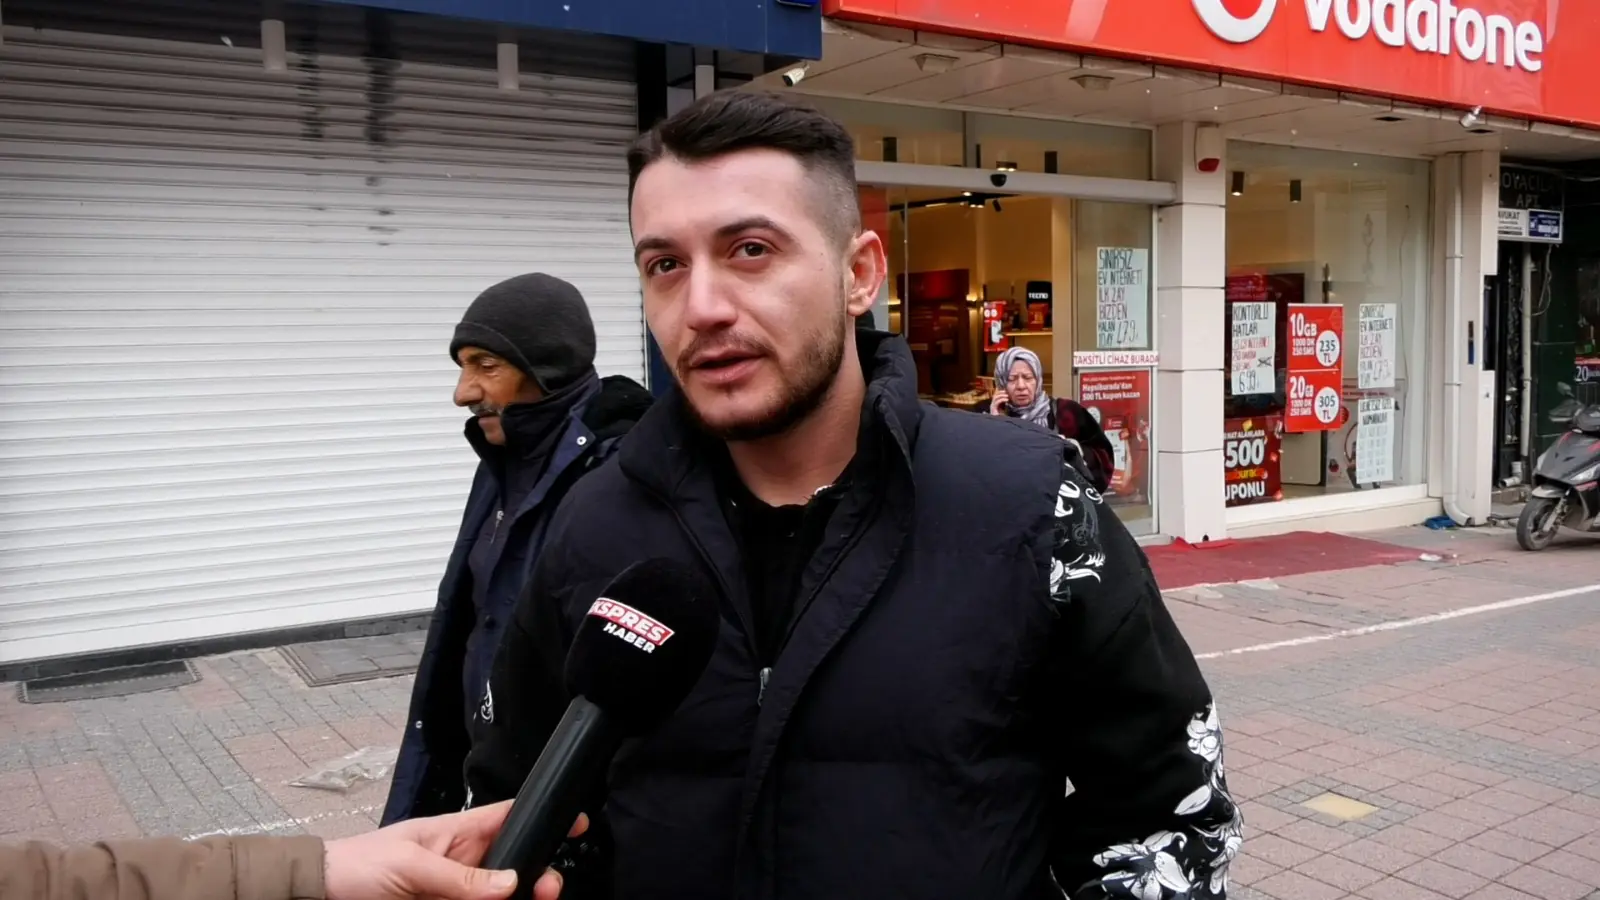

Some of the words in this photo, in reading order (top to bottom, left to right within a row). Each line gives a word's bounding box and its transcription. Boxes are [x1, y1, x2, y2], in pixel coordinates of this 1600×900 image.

[1303, 0, 1543, 72] vodafone
[1028, 292, 1049, 300] TECNO
[1319, 339, 1336, 352] 235
[1074, 353, 1106, 365] TAKSİTLİ
[1130, 354, 1159, 365] BURADA
[1323, 352, 1332, 363] TL
[1318, 395, 1335, 408] 305
[1322, 409, 1331, 420] TL
[1225, 438, 1265, 468] 500
[603, 621, 656, 654] HABER
